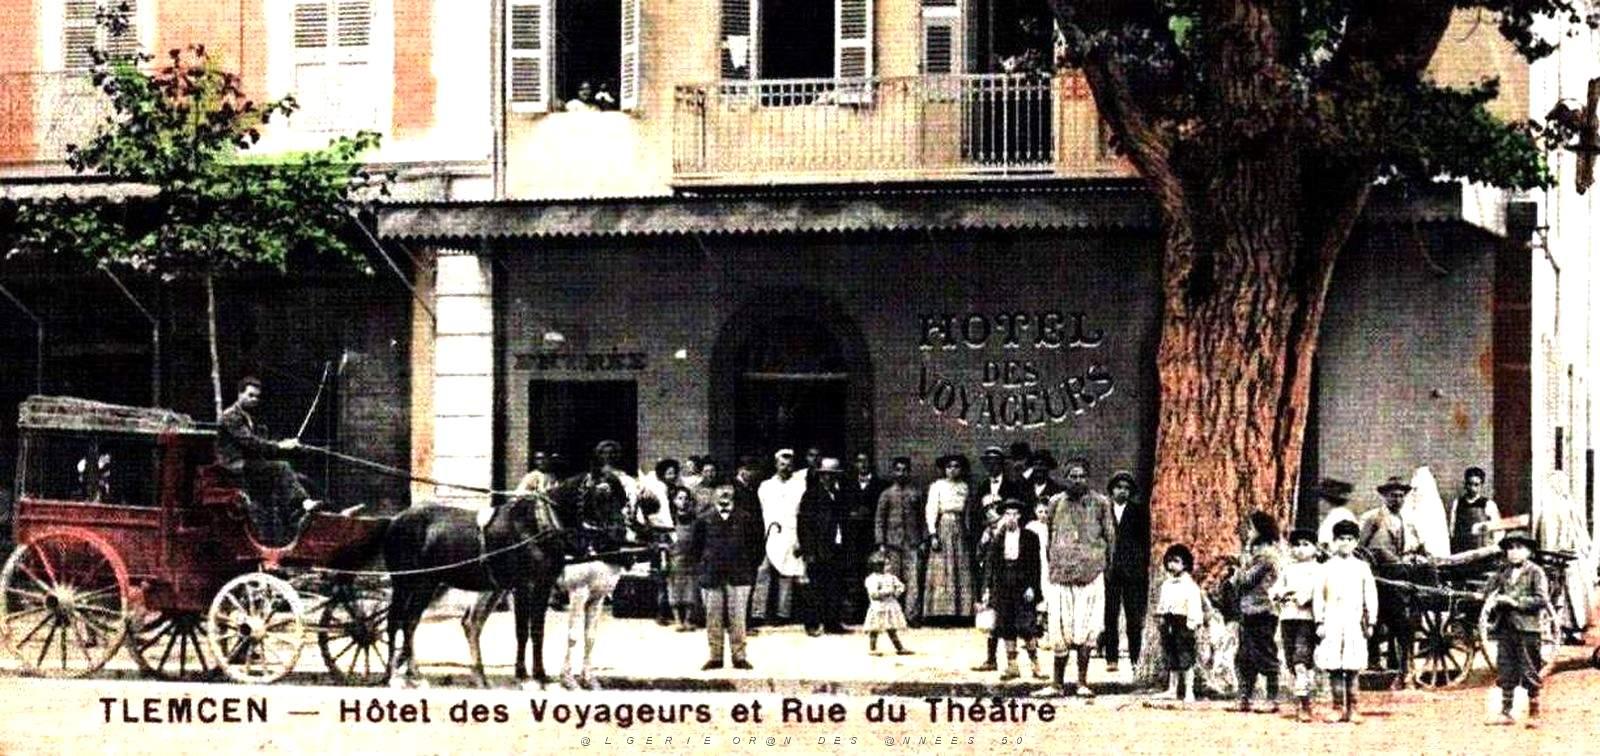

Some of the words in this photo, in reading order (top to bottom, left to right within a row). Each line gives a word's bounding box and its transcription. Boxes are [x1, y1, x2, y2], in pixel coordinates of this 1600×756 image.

[919, 312, 1105, 350] HOTEL
[982, 361, 1037, 388] DES
[918, 359, 1115, 431] VOYAGEURS
